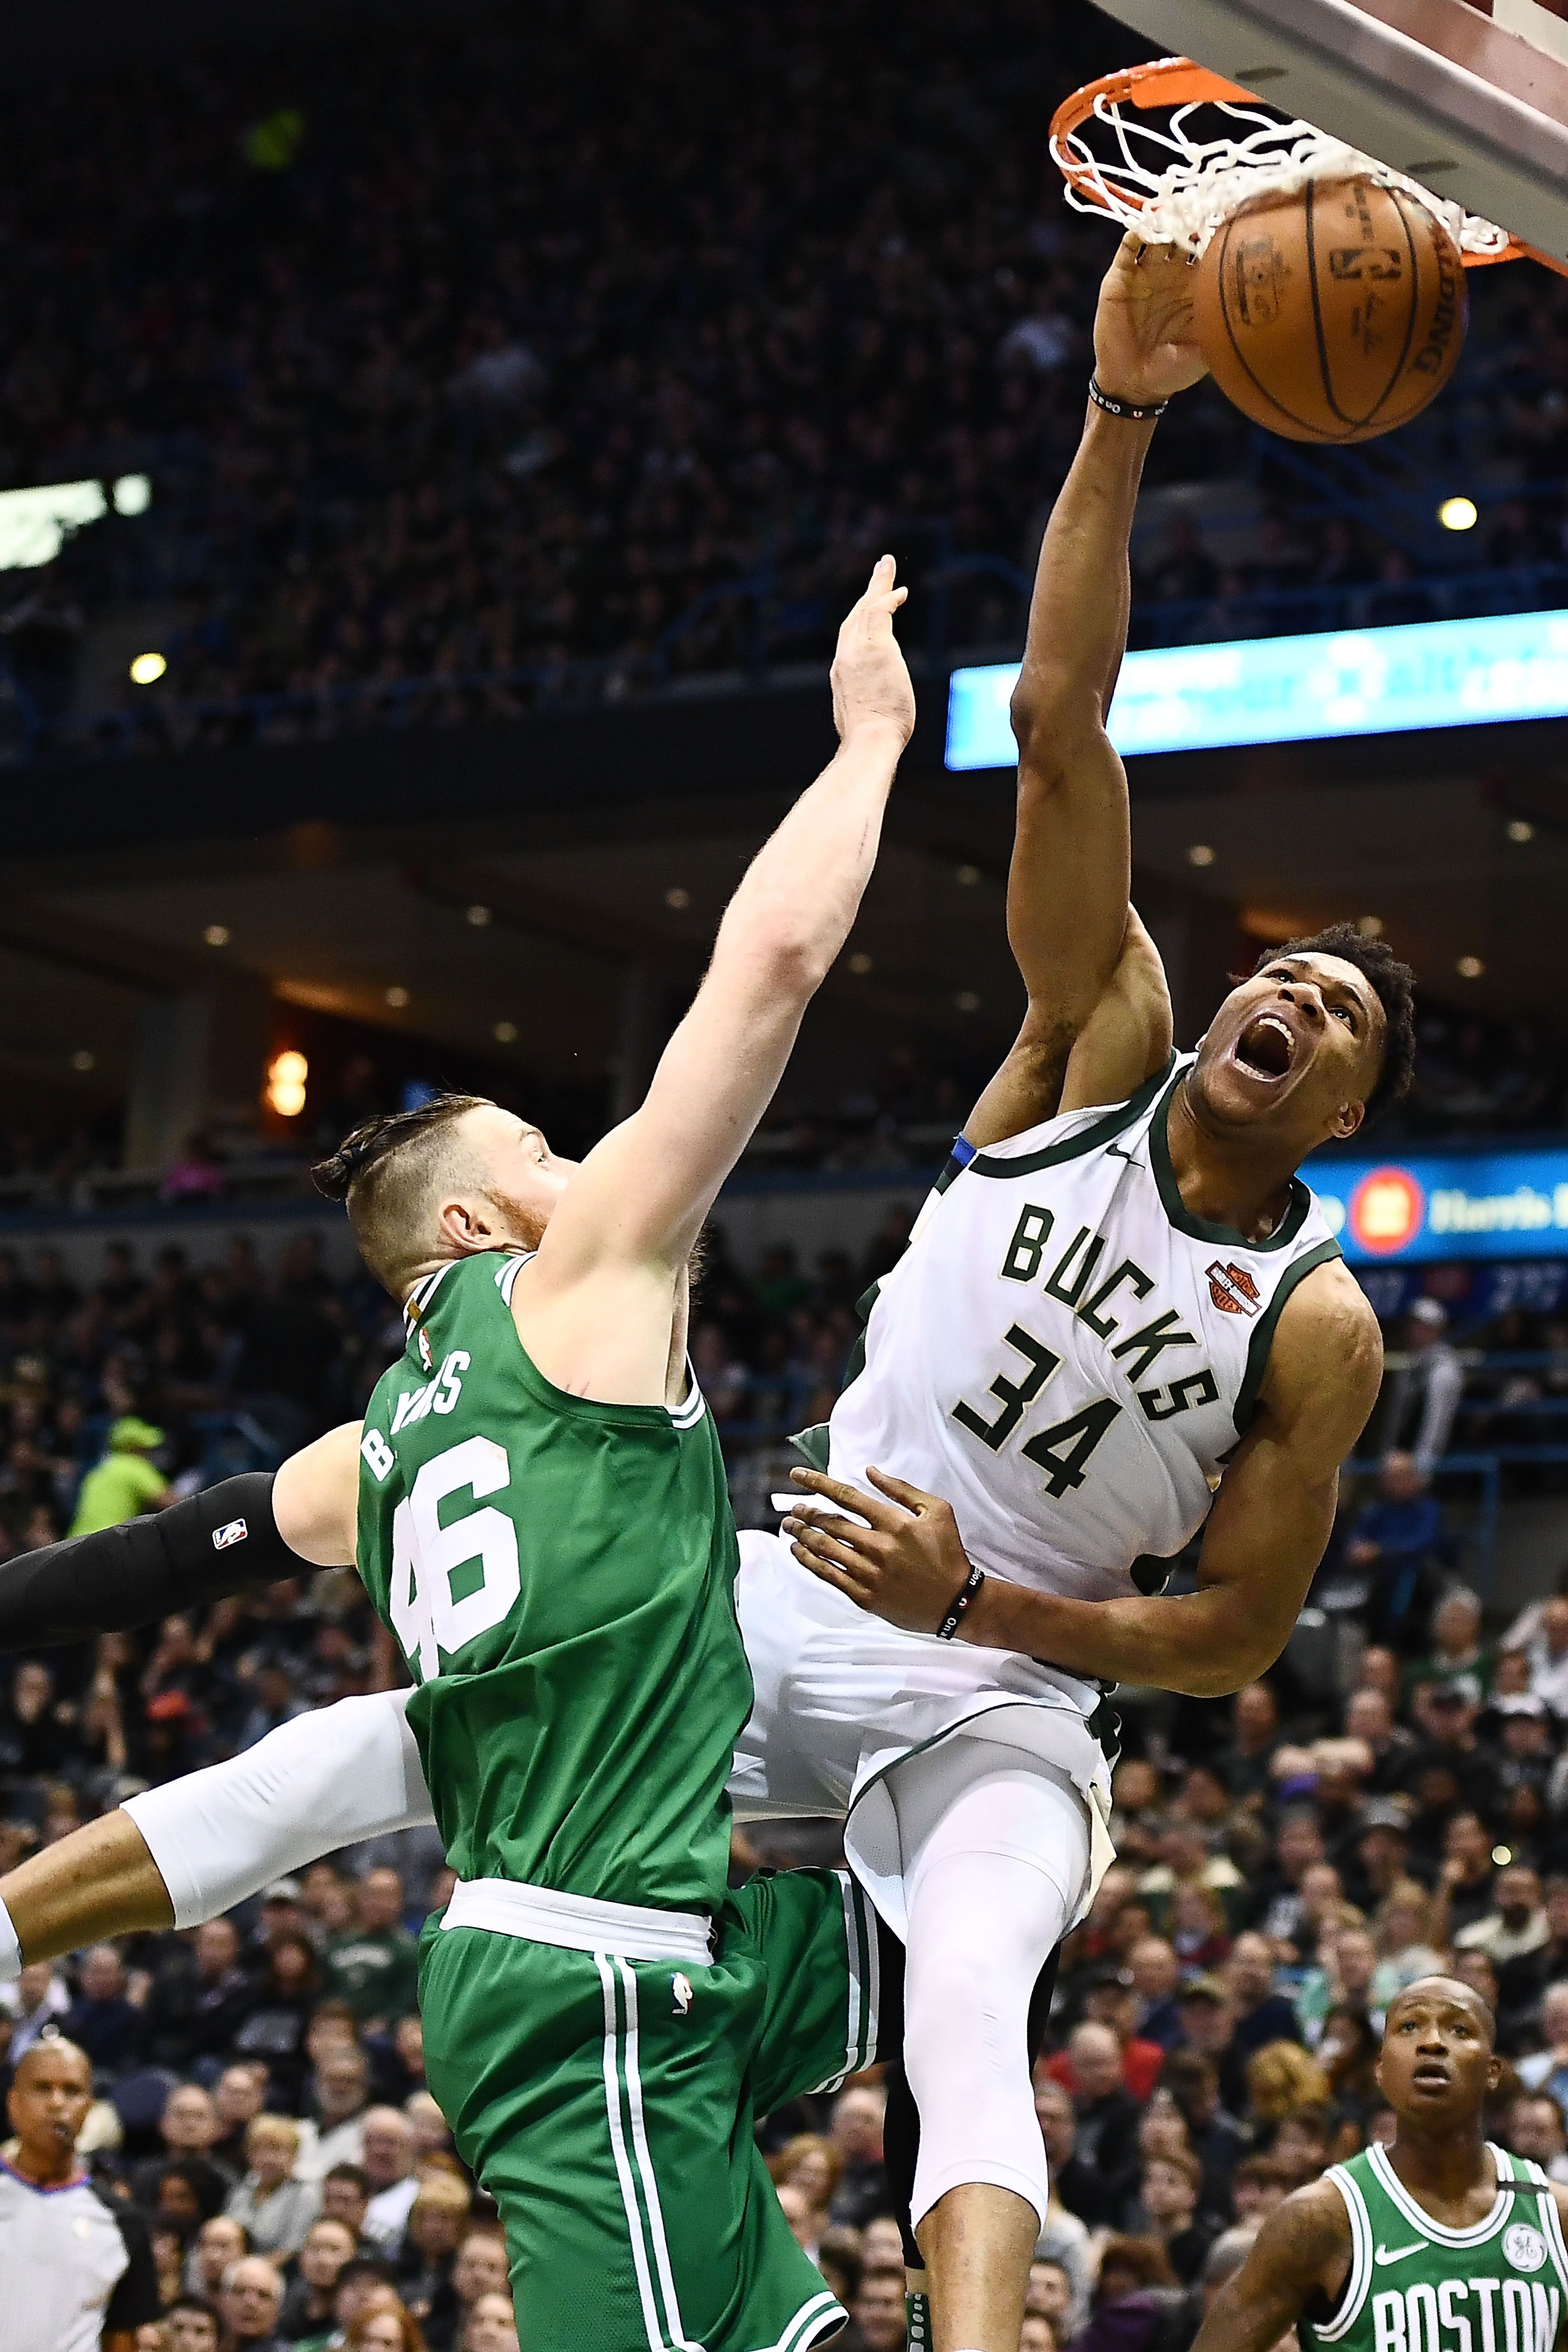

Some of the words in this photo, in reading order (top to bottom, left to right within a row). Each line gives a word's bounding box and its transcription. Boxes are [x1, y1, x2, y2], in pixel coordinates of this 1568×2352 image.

[999, 1202, 1220, 1421] BUCKS
[950, 1322, 1127, 1500] 34
[390, 1435, 520, 1680] 46
[1372, 2277, 1560, 2352] BOSTON
